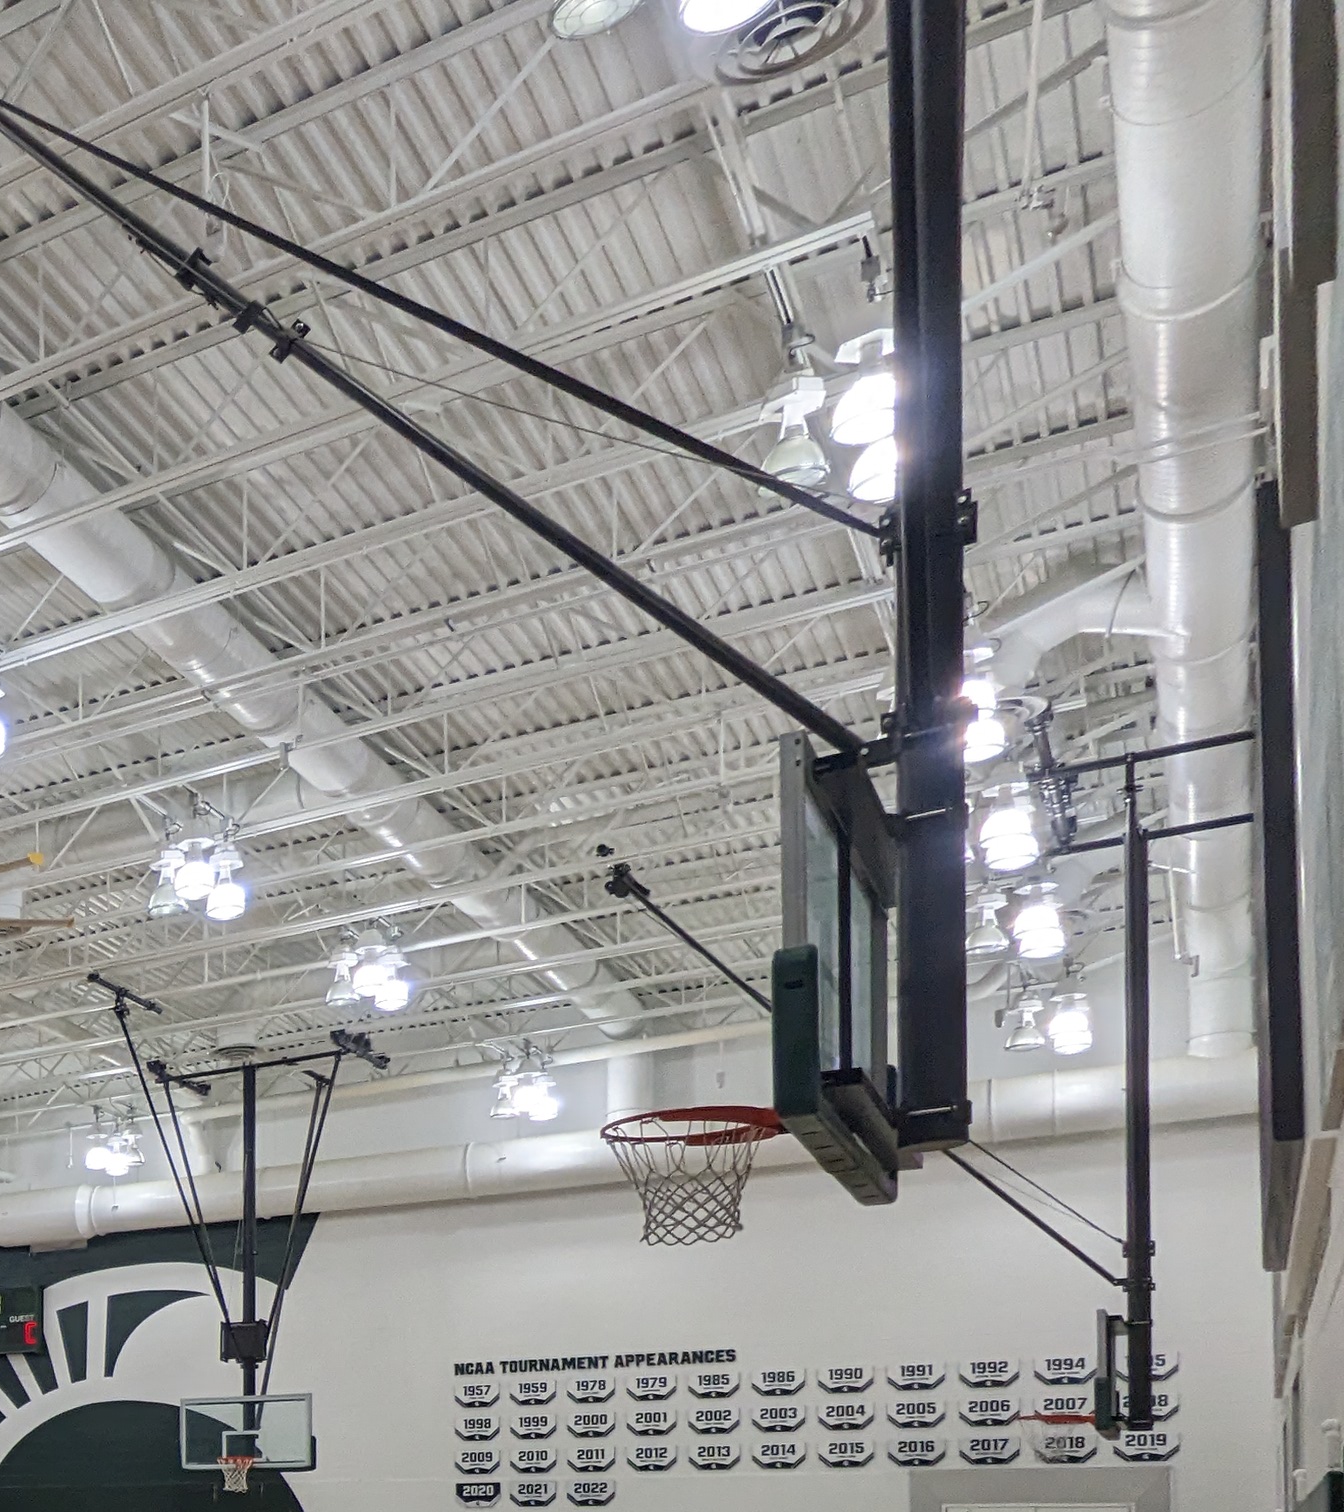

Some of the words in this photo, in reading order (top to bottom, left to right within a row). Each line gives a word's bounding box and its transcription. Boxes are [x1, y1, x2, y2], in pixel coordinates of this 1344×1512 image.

[9, 1314, 35, 1323] GUEST
[454, 1361, 495, 1376] NCAA
[499, 1355, 609, 1374] TOURNAMENT
[614, 1348, 737, 1369] APPEARANCES
[462, 1384, 491, 1397] 1957
[518, 1381, 547, 1394] 1959
[575, 1379, 606, 1391] 1978
[635, 1376, 667, 1389] 1979
[697, 1373, 730, 1386] 1985
[761, 1370, 795, 1383] 1986
[828, 1367, 863, 1380] 1990
[900, 1364, 934, 1377] 1991
[970, 1360, 1009, 1374] 1992
[1045, 1357, 1086, 1372] 1994
[463, 1418, 491, 1430] 1998
[518, 1415, 548, 1428] 1999
[574, 1413, 607, 1426] 2000
[635, 1411, 667, 1424] 2001
[696, 1409, 732, 1422] 2002
[760, 1407, 797, 1420] 2003
[825, 1404, 866, 1418] 2004
[895, 1402, 936, 1415] 2005
[968, 1399, 1010, 1413] 2006
[1043, 1397, 1088, 1411] 2007
[461, 1451, 493, 1463] 2009
[518, 1450, 548, 1462] 2010
[577, 1448, 605, 1461] 2011
[635, 1447, 668, 1459] 2012
[697, 1445, 731, 1458] 2013
[760, 1443, 796, 1457] 2014
[828, 1442, 865, 1455] 2015
[897, 1440, 934, 1453] 2016
[970, 1438, 1009, 1452] 2017
[1044, 1436, 1085, 1450] 2018
[1125, 1433, 1167, 1447] 2019
[462, 1484, 494, 1497] 2020
[518, 1483, 548, 1495] 2021
[573, 1482, 607, 1494] 2022
